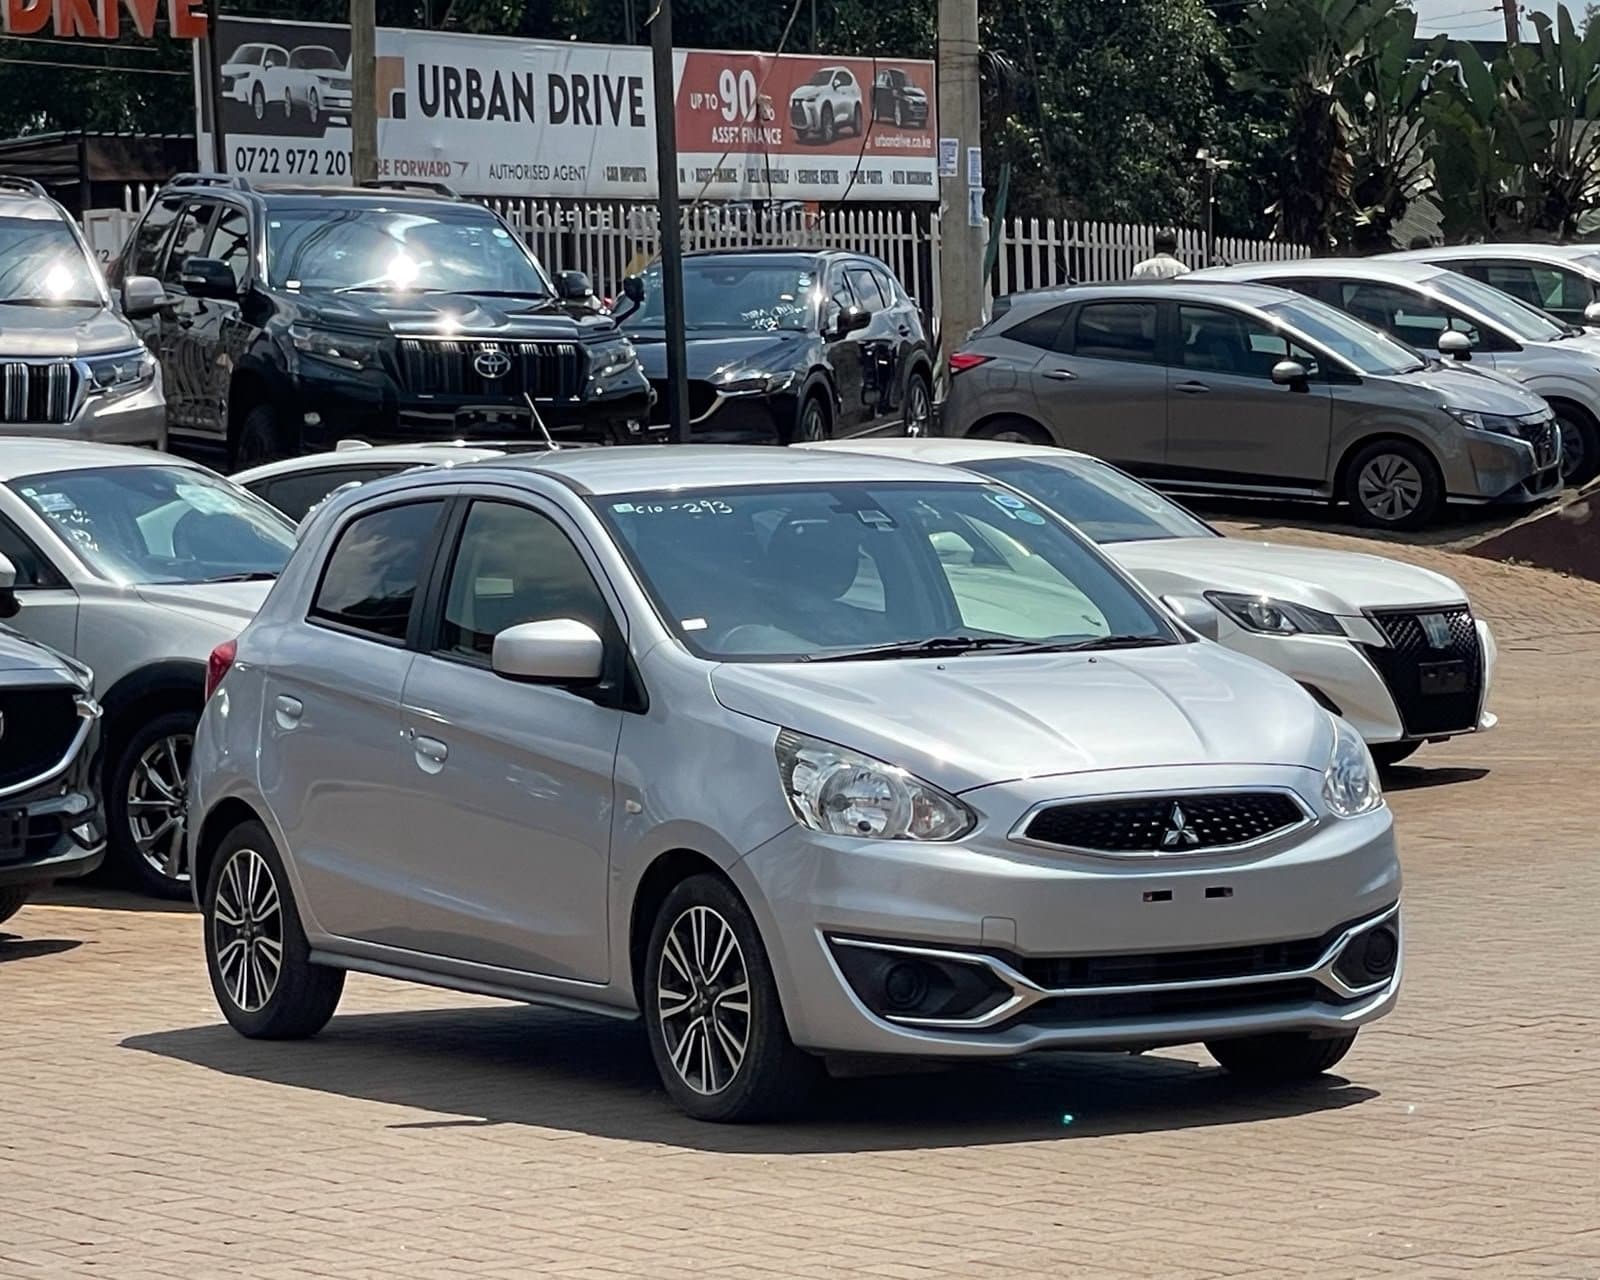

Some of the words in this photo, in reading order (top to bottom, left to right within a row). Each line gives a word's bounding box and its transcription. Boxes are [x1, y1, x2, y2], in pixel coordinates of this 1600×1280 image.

[418, 63, 536, 124] URBAN
[548, 73, 646, 128] DRIVE
[690, 92, 703, 110] UP
[704, 93, 718, 111] TO
[741, 127, 783, 145] FINANCE
[235, 146, 280, 173] 0722
[286, 149, 319, 175] 972
[394, 159, 452, 178] FORWARD
[489, 160, 550, 182] AUTHORISED
[553, 163, 588, 183] AGENT
